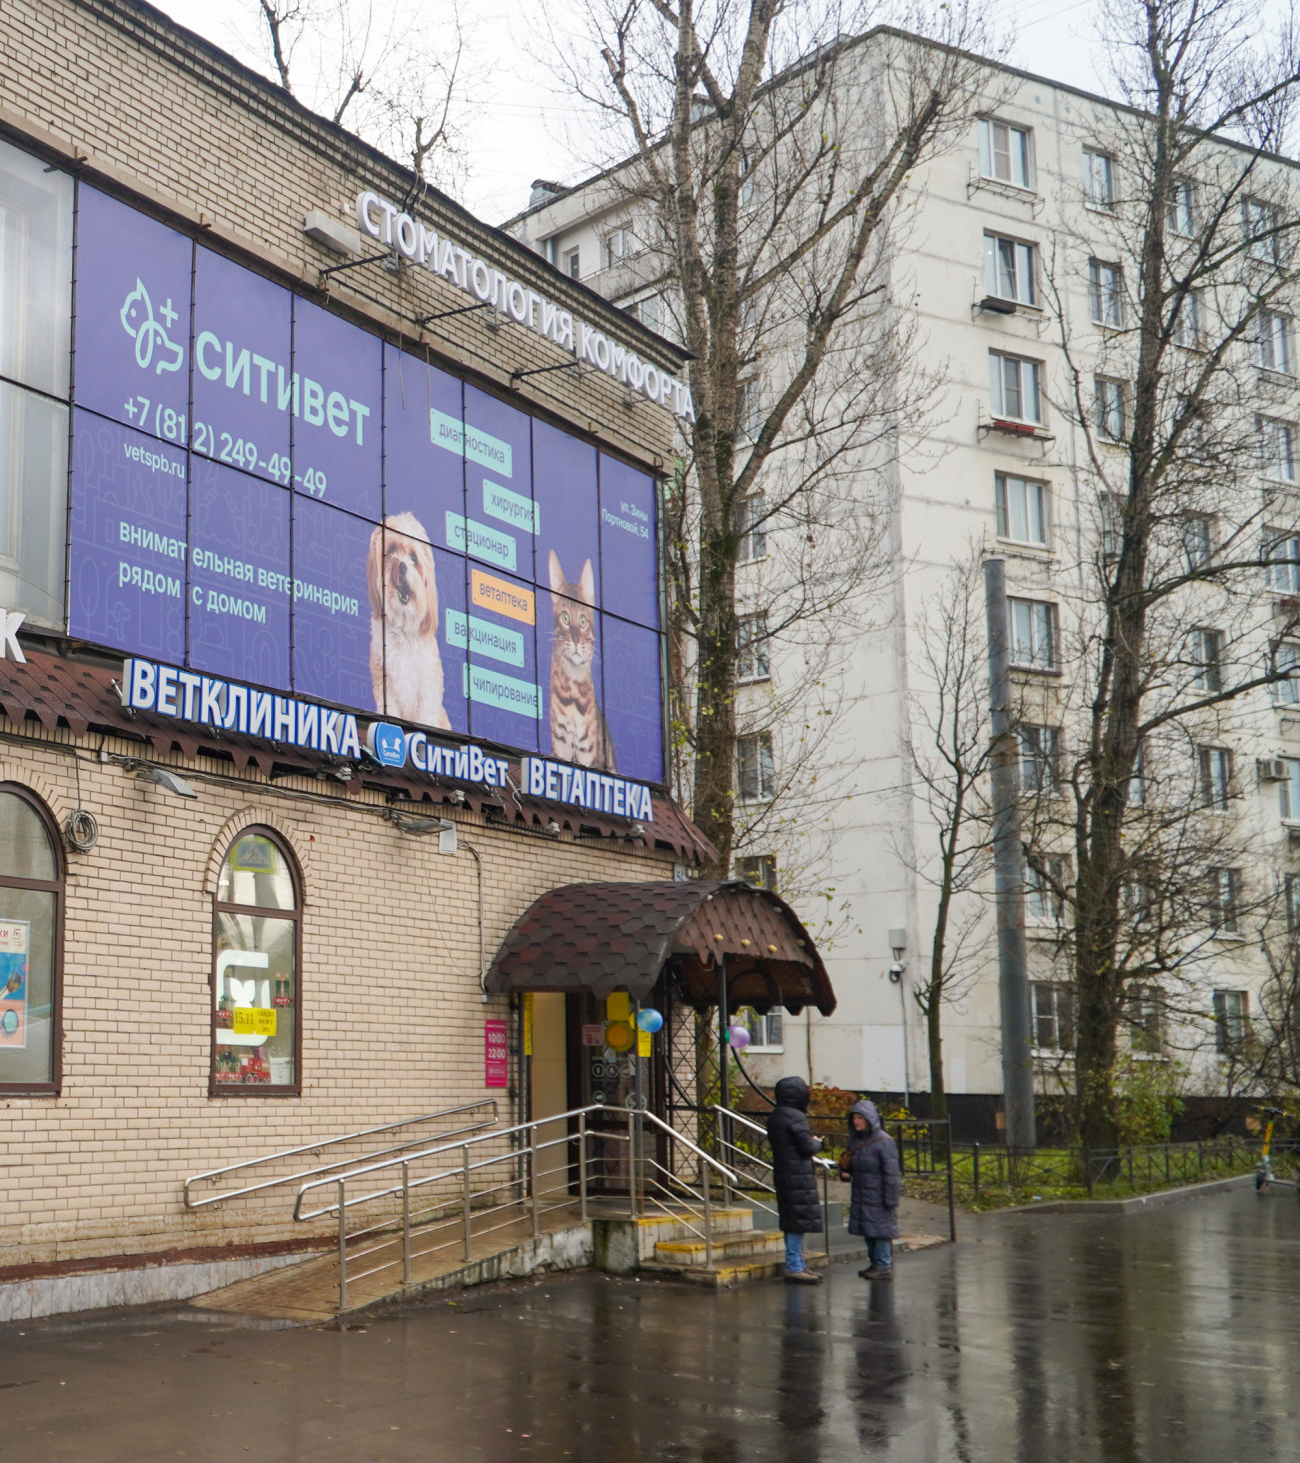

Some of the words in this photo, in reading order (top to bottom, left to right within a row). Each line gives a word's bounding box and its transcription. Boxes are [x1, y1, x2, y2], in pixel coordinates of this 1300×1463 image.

[356, 190, 573, 350] СТОМАТОЛОГИЯ
[576, 322, 696, 424] КОМФОРТА
[124, 395, 150, 427] +7
[221, 432, 327, 498] 249-49-49
[124, 442, 185, 479] vetspb.ru
[439, 424, 505, 464] диагностика
[491, 492, 534, 522] хирургия
[631, 504, 649, 522] Зины
[454, 524, 509, 560] стационар
[640, 526, 649, 539] 54
[120, 521, 254, 583] внимательная
[258, 568, 359, 617] ветеринария
[119, 561, 181, 599] рядом
[192, 586, 203, 605] с
[207, 590, 266, 624] домом
[479, 582, 528, 612] ветаптека
[454, 622, 517, 655] вакцинация
[473, 676, 538, 709] чипирование
[122, 657, 362, 759] ВЕТКЛИНИКА
[406, 731, 509, 788] СитиВет
[521, 757, 654, 822] ВЕТАПТЕКА
[234, 1012, 254, 1025] 15.11
